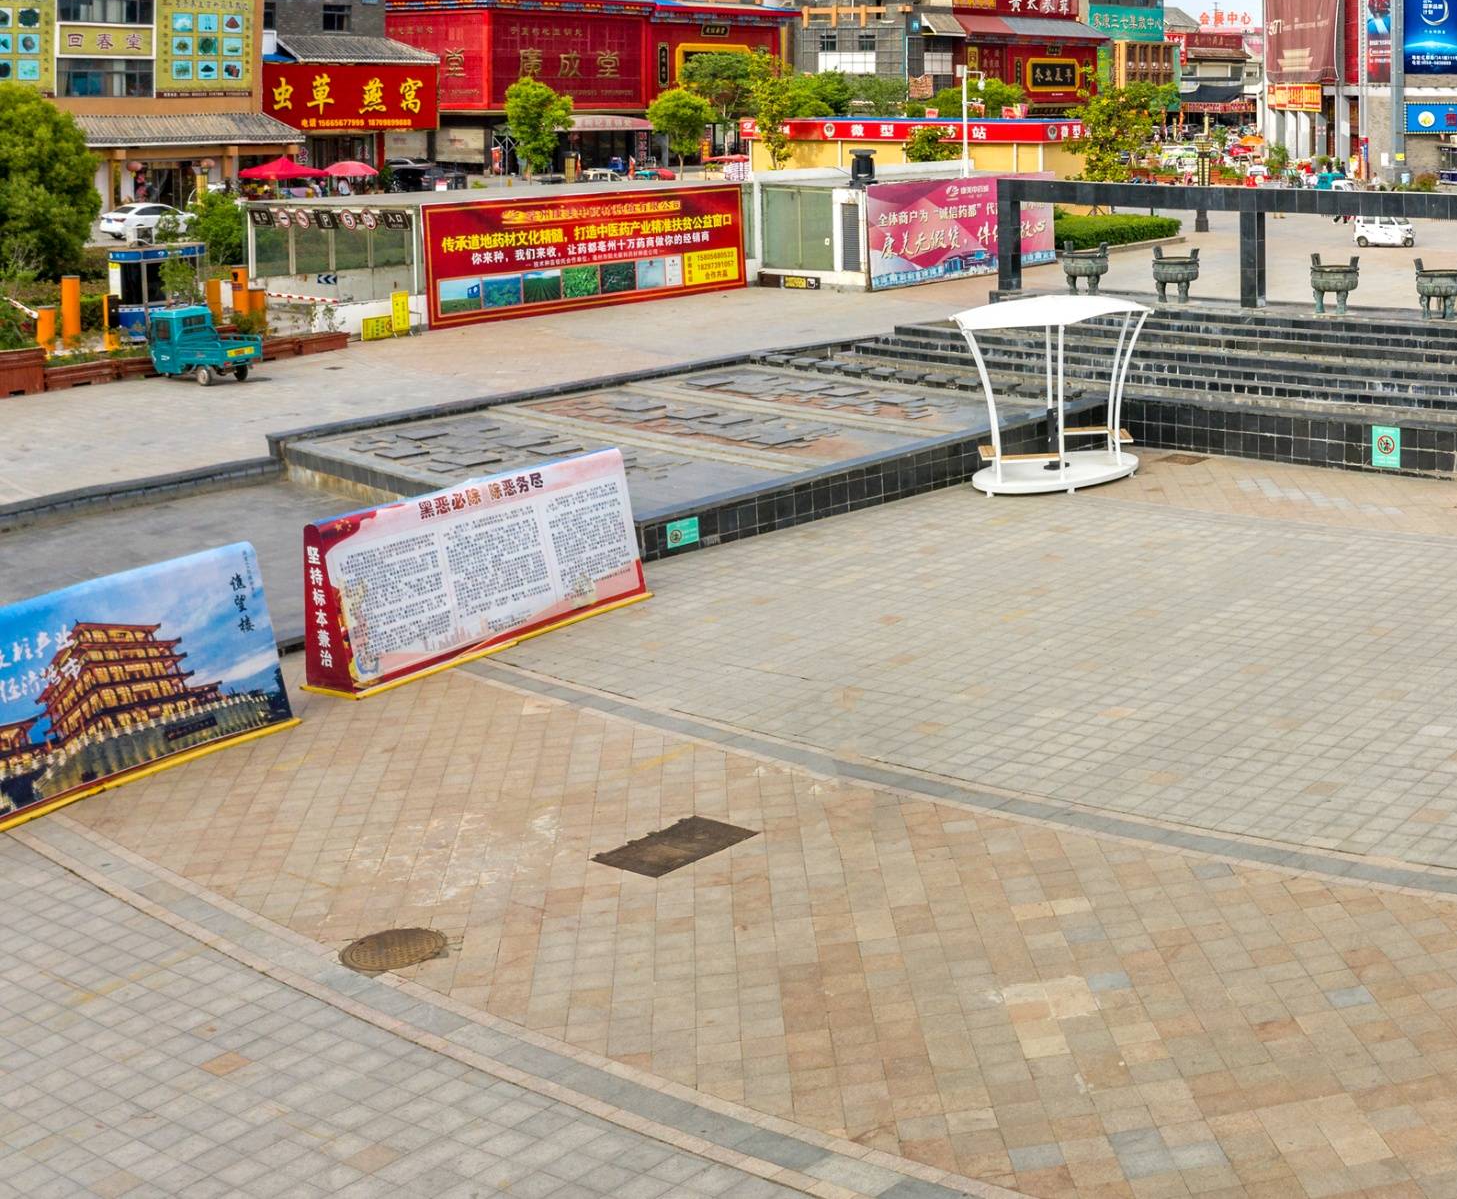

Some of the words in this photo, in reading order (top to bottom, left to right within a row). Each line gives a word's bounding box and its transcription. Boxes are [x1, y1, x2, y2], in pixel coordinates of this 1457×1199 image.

[1199, 11, 1251, 25] 会展中心
[67, 33, 144, 51] 回春堂
[301, 118, 316, 128] 电话
[345, 215, 352, 225] 5
[388, 213, 404, 223] 入口
[418, 486, 482, 520] 黑恶必除
[488, 472, 544, 500] 除恶务尽
[306, 545, 333, 668] 坚持标本兼治
